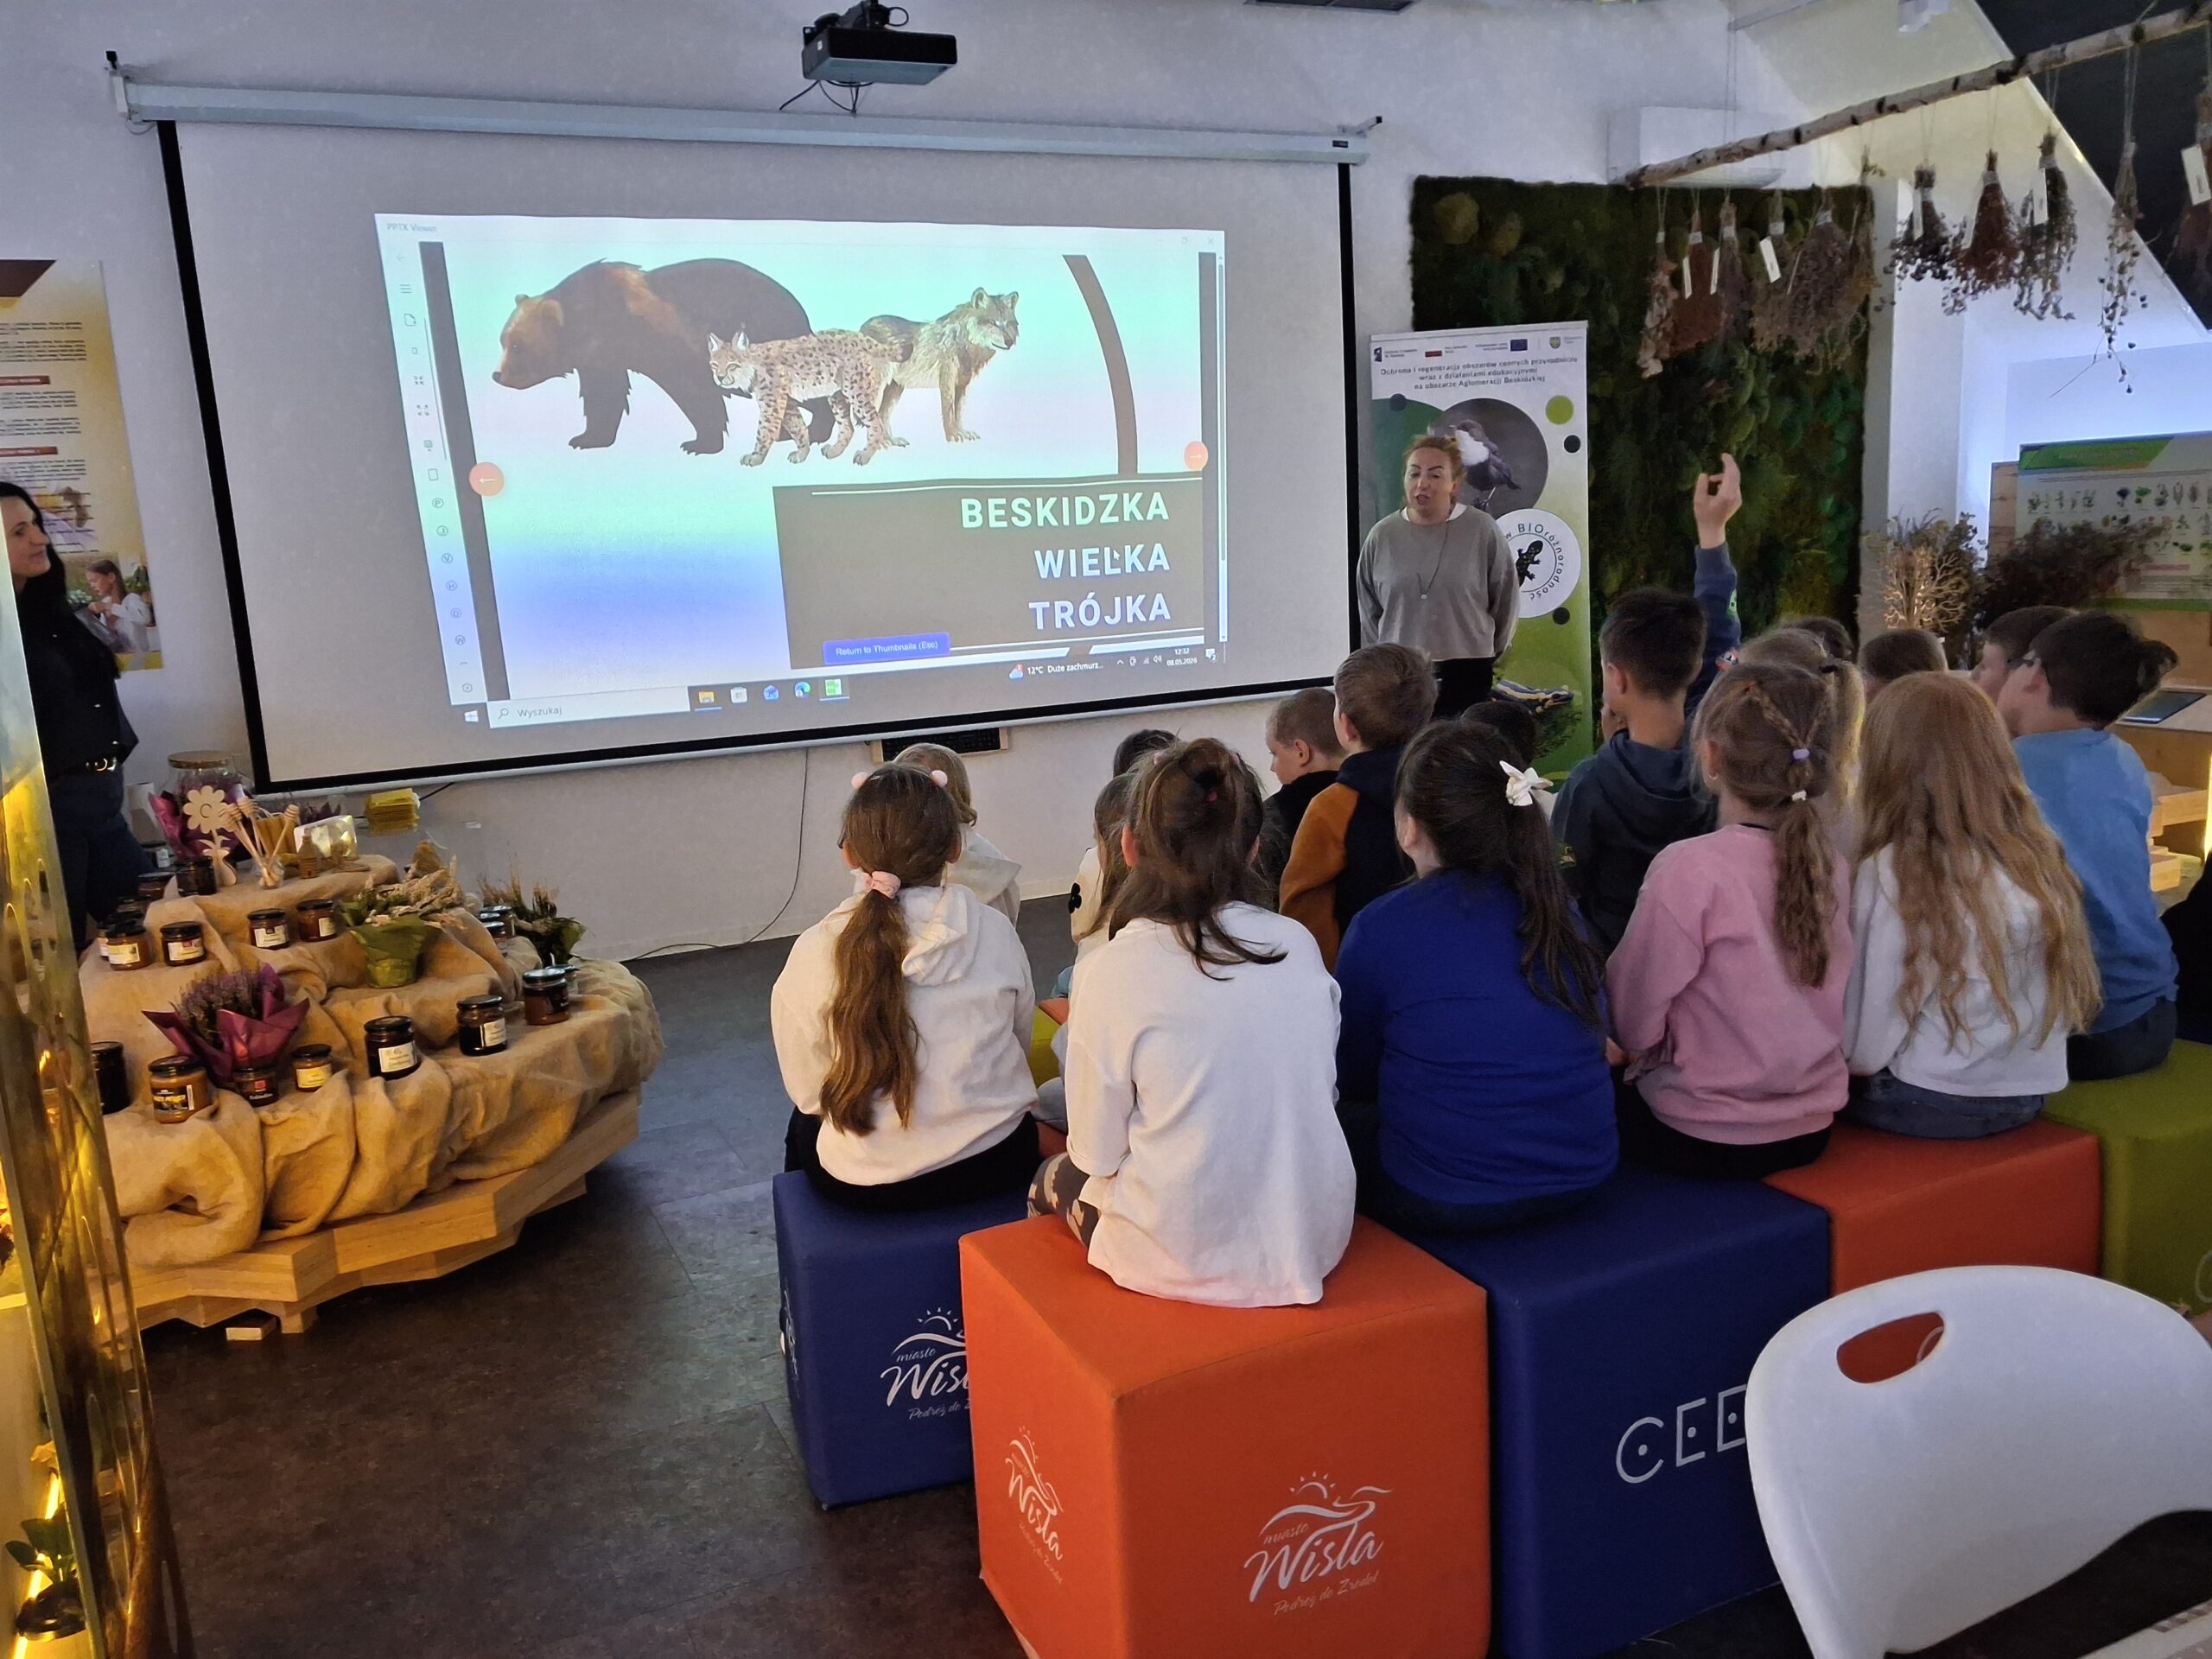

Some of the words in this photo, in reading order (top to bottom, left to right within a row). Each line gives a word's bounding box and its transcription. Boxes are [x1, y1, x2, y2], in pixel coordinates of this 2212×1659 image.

[1380, 366, 1412, 376] Ochrona
[1417, 364, 1460, 374] regeneracja
[1459, 378, 1502, 388] Aglomeracji
[961, 491, 1170, 529] BESKIDZKA
[1034, 542, 1170, 580] WIELKA
[1028, 591, 1171, 630] TRÓJKA
[836, 647, 862, 657] Return
[874, 643, 917, 654] Thumbnails
[918, 640, 938, 651] (Esc)
[517, 706, 562, 718] Wyszukaj
[896, 1347, 936, 1363] miasto
[880, 1351, 969, 1408] Wis
